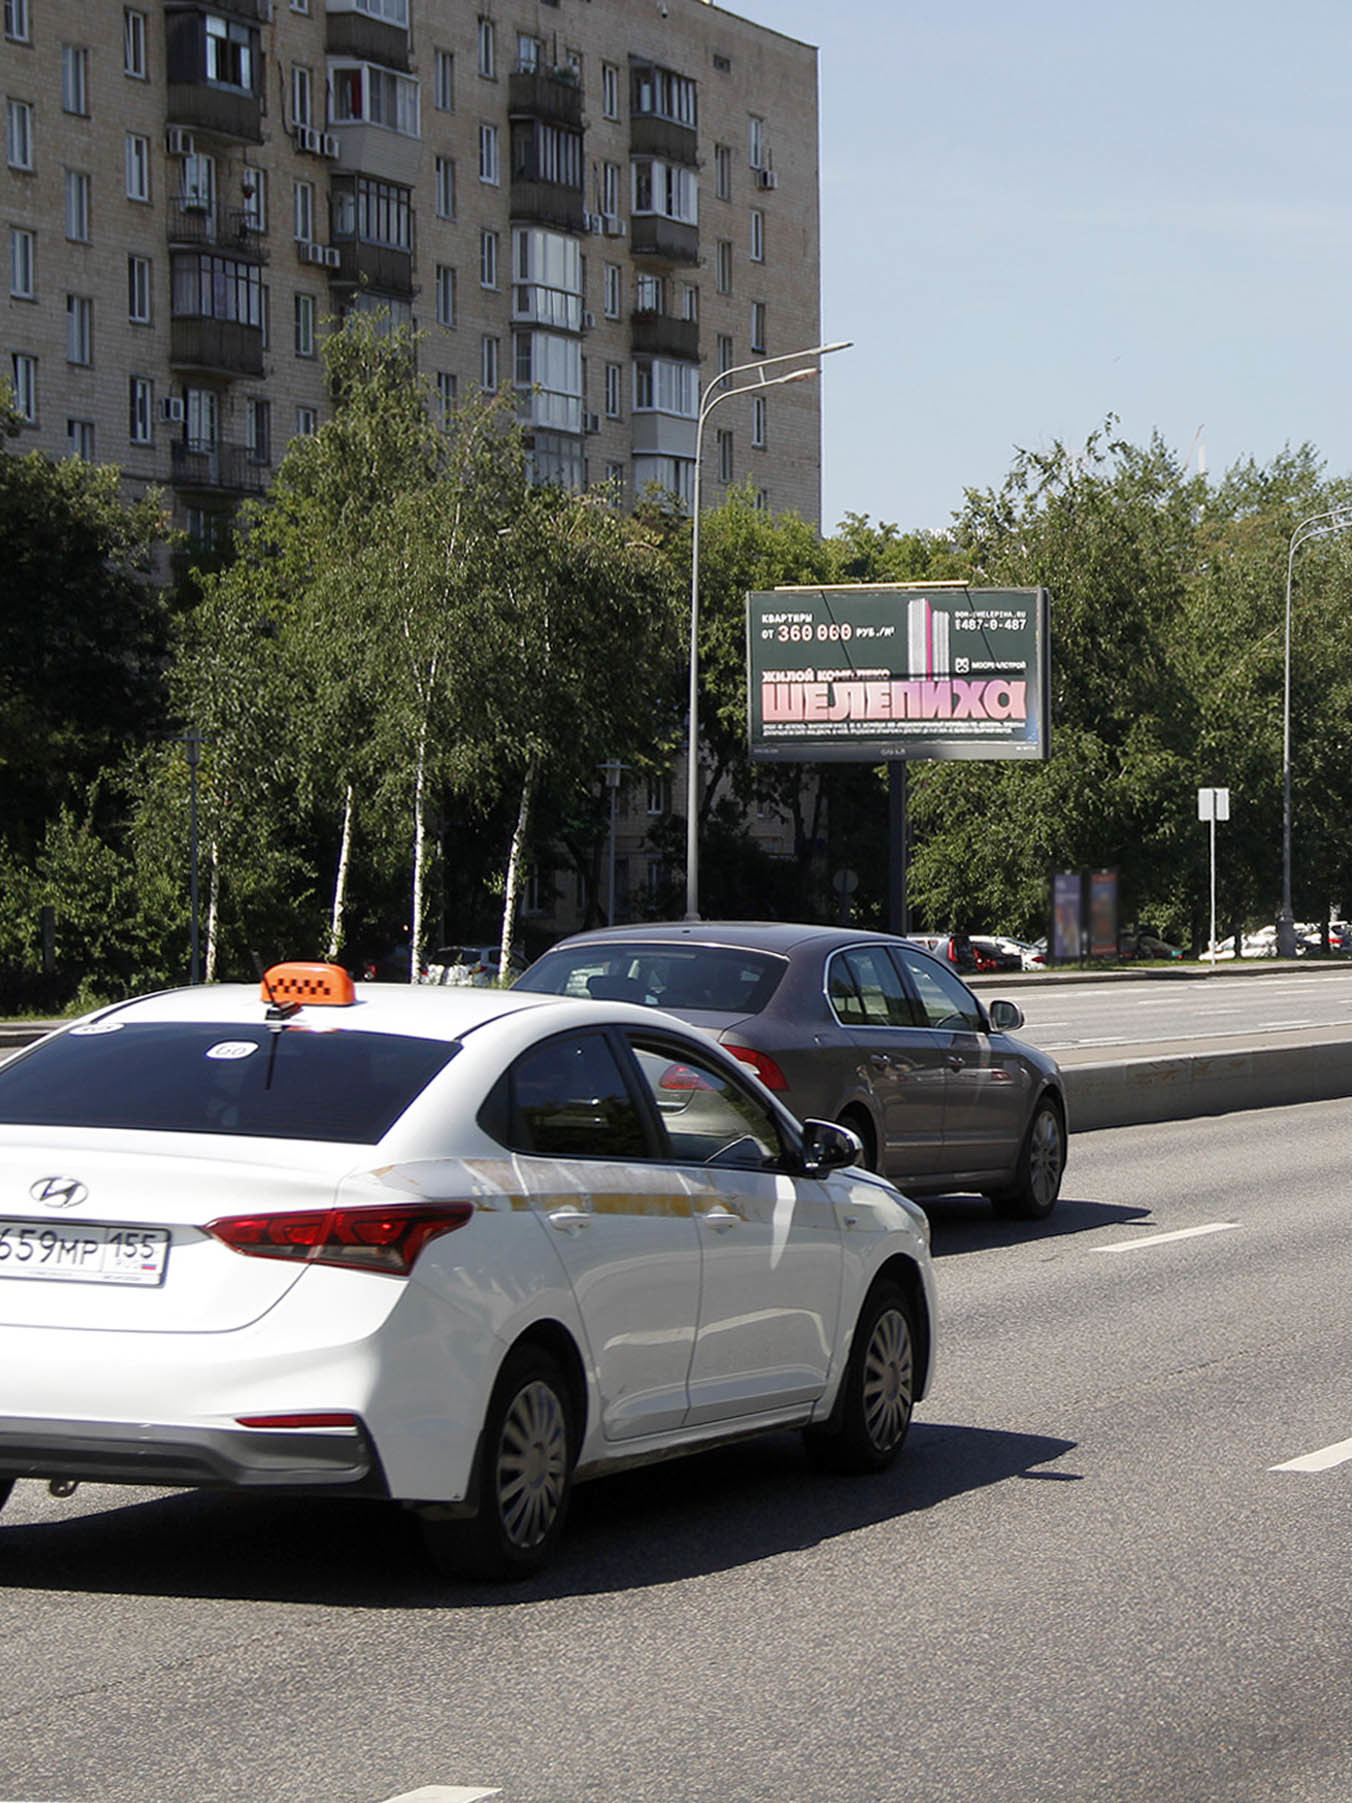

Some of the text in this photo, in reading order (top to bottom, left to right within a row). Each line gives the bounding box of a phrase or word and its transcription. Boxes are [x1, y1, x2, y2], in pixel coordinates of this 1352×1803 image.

[761, 613, 813, 623] КВАРТИРЫ
[761, 629, 774, 639] ОТ
[778, 624, 813, 641] 360
[817, 623, 852, 641] 000
[762, 667, 815, 683] ЖИЛОЙ
[762, 679, 1027, 722] ШЕЛЕПИХА
[109, 1231, 157, 1259] 155
